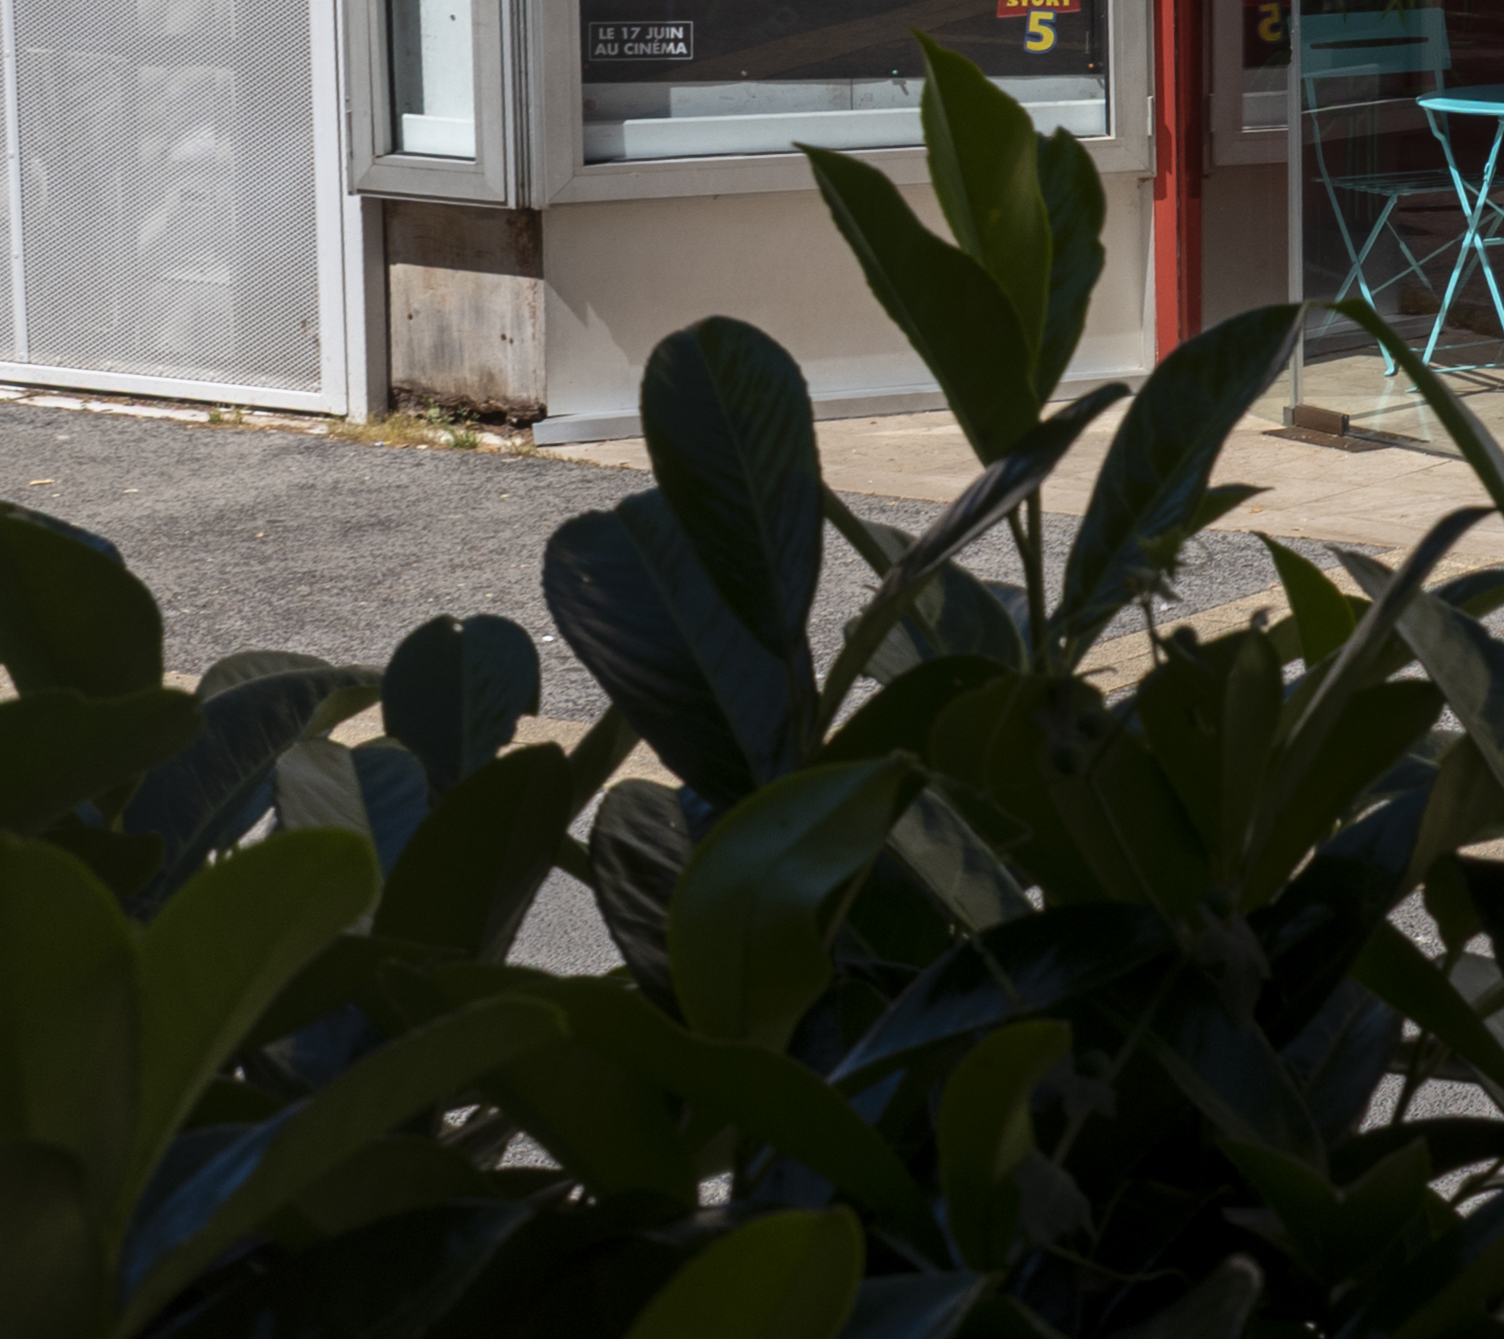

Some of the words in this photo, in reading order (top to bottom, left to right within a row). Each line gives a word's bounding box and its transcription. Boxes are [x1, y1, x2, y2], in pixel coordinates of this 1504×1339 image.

[599, 28, 615, 39] LE
[622, 27, 640, 39] 17
[645, 27, 683, 39] JUIN
[1023, 9, 1057, 54] 5
[595, 43, 619, 55] AU
[624, 39, 687, 54] CINÉMA
